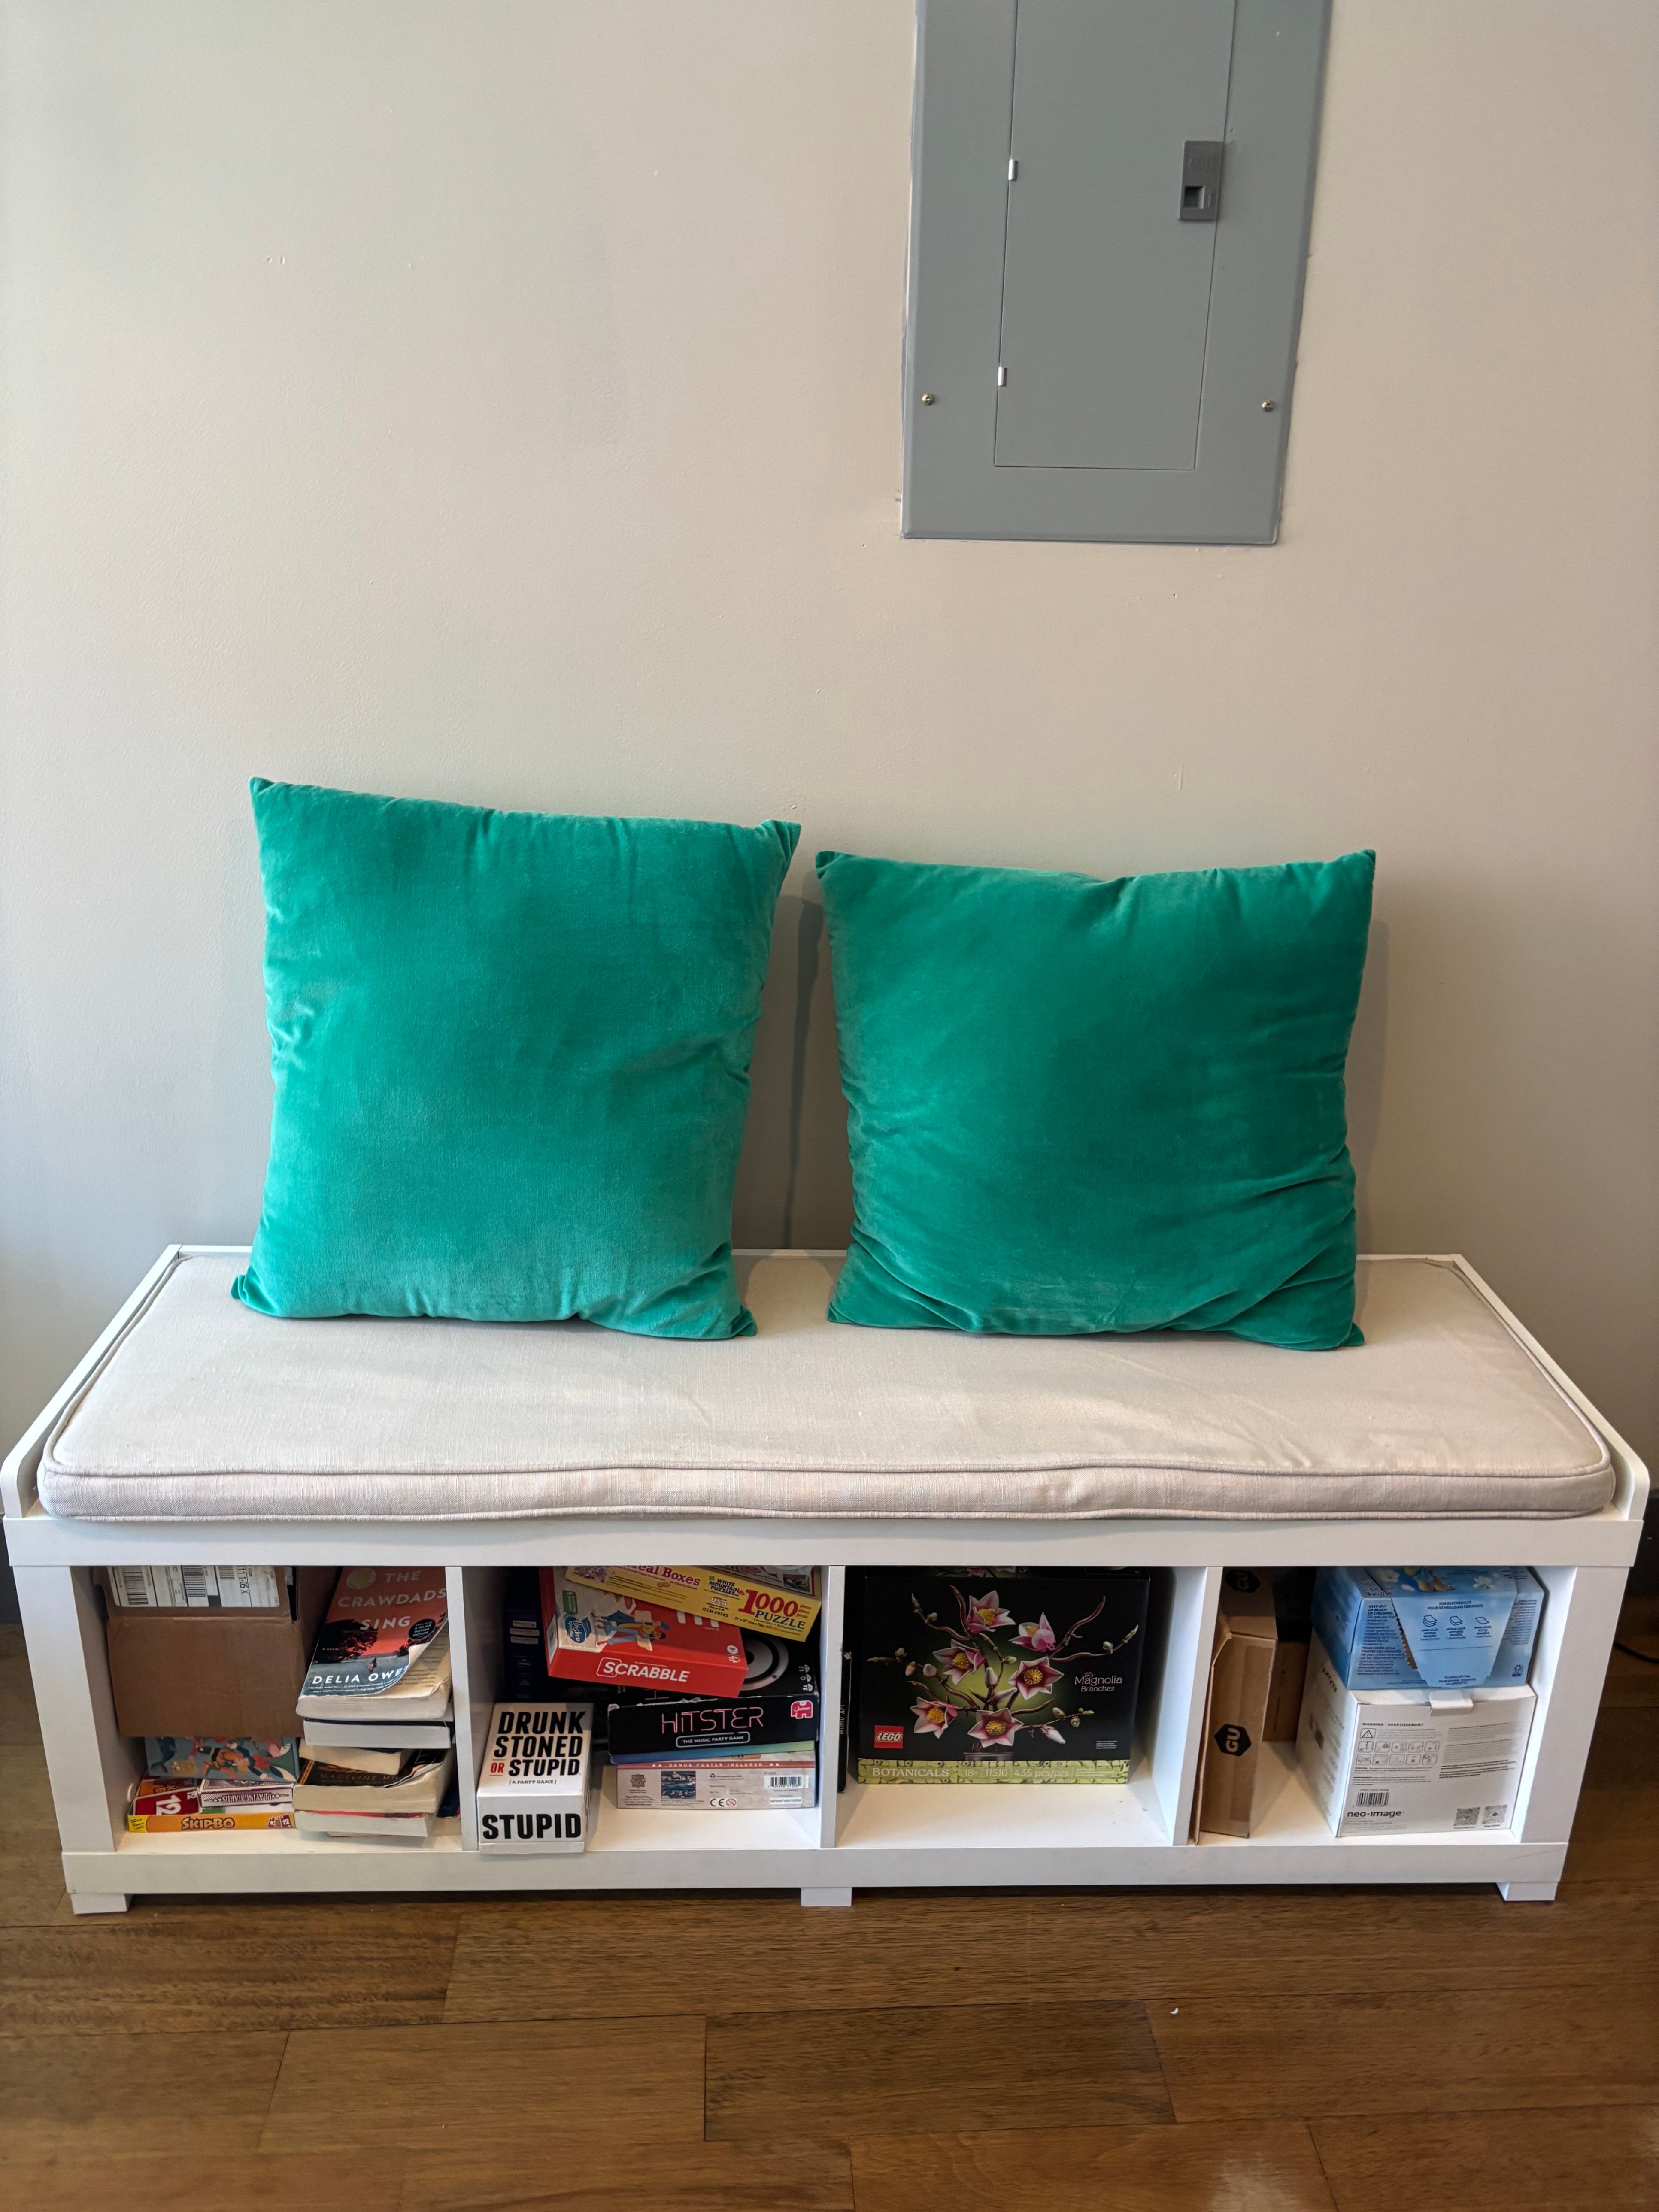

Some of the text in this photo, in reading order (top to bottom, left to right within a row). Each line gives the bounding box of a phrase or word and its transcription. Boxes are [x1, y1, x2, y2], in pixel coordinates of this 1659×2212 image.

[385, 1570, 421, 1583] THE
[661, 1567, 701, 1586] Boxes
[717, 1578, 735, 1587] WHITE
[709, 1581, 739, 1593] MOUNTAIN
[710, 1585, 735, 1595] PUZZLES
[338, 1588, 447, 1607] CRAWDADS
[711, 1597, 727, 1606] USA
[738, 1589, 798, 1617] 1000
[360, 1616, 411, 1630] SING
[755, 1610, 806, 1629] PUZZLE
[573, 1618, 582, 1642] Hasbro
[312, 1674, 360, 1684] DELIA
[603, 1661, 690, 1682] SCRABBLE
[1074, 1675, 1122, 1686] Magnolia
[497, 1711, 586, 1734] DRUNK
[661, 1707, 764, 1734] HITSTER
[876, 1732, 902, 1742] LEGO
[1225, 1727, 1240, 1752] GU
[494, 1736, 583, 1758] STONED
[490, 1759, 580, 1776] OR STUPID
[872, 1767, 949, 1777] BOTANICALS
[965, 1769, 978, 1777] 18+
[986, 1769, 1007, 1777] 11510
[1014, 1768, 1032, 1776] 435
[1034, 1769, 1069, 1778] pcs/pzs
[156, 1795, 181, 1815] 12
[222, 1792, 273, 1803] PLAYING CARDS
[482, 1813, 582, 1839] STUPID
